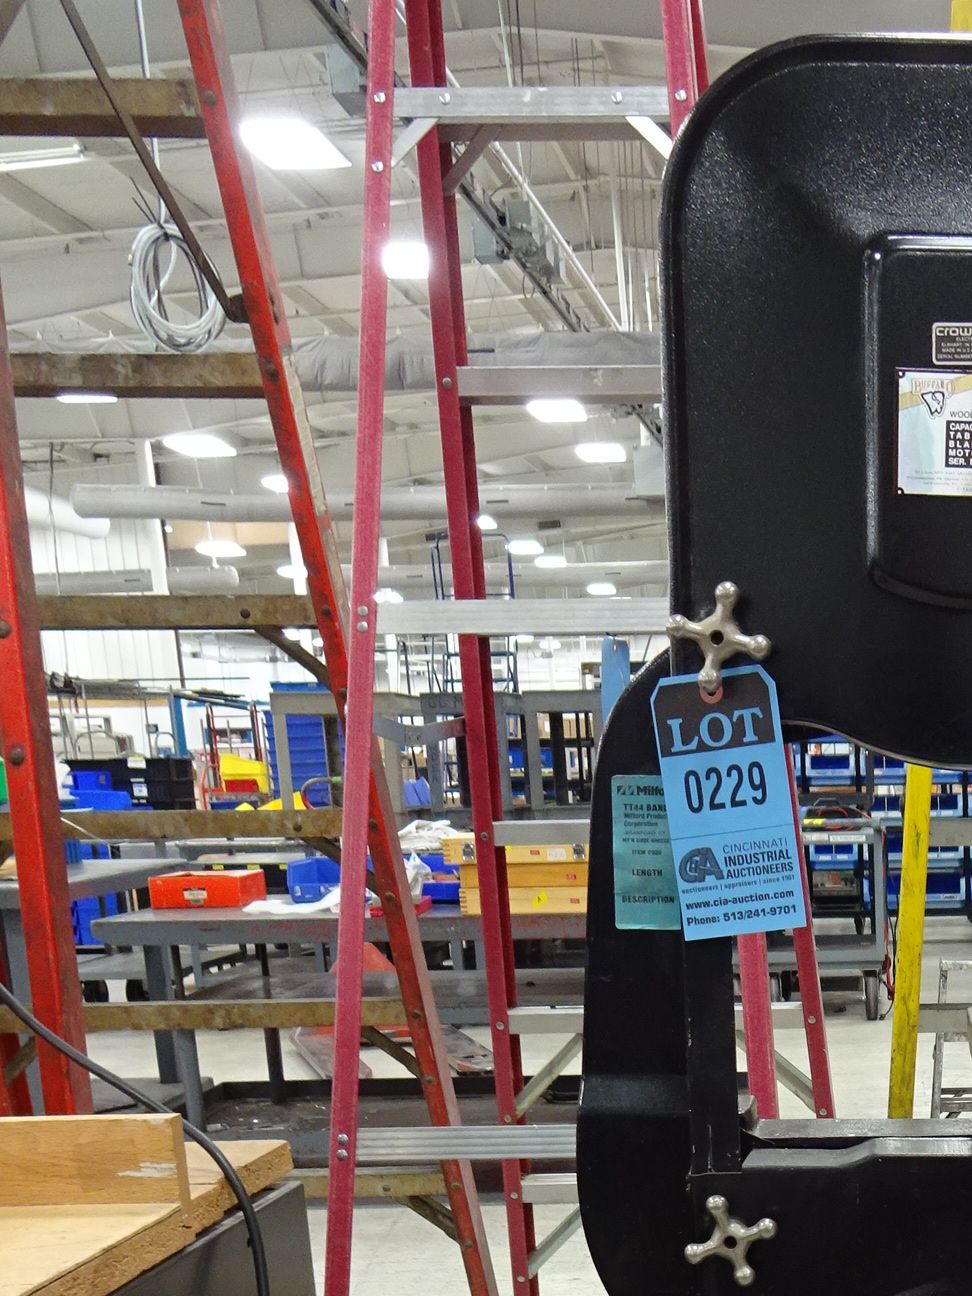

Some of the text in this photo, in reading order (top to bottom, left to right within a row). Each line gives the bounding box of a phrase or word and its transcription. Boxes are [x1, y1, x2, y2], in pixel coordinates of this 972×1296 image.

[948, 457, 966, 466] SER.
[667, 706, 763, 752] LOT
[636, 785, 664, 796] Milfo
[683, 761, 768, 814] 0229
[722, 837, 788, 854] CINCINNATI
[724, 849, 792, 867] INDUSTRIAL
[632, 868, 663, 877] LENGTH
[726, 862, 794, 880] AUCTIONEERS
[622, 895, 675, 904] DESCRIPTION
[686, 890, 794, 911] www.cia-auction.com
[686, 904, 797, 927] Phone: 513/241-9701
